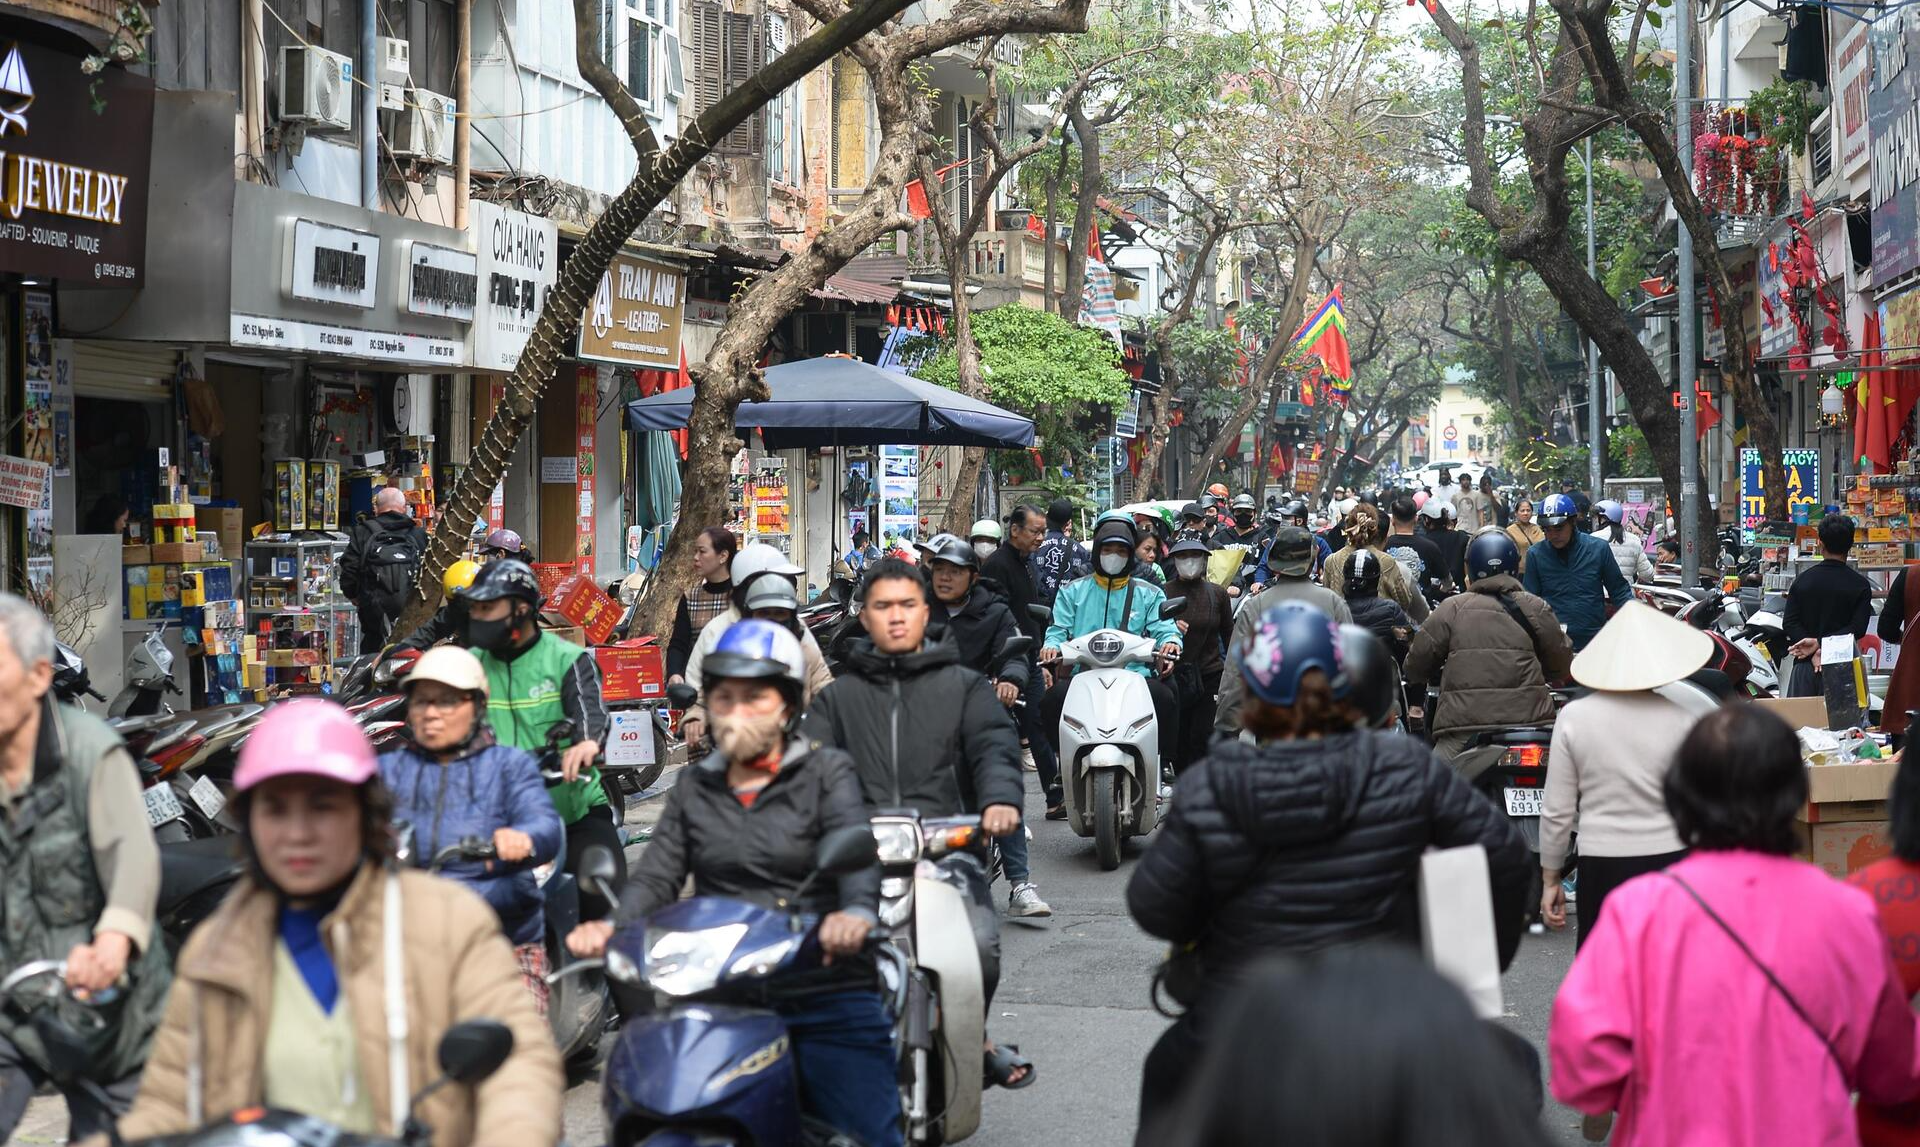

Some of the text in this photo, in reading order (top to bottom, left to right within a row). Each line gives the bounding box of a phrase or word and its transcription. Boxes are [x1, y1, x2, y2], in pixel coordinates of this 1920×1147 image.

[10, 154, 128, 224] JEWELRY
[32, 227, 68, 248] SOUVENIR
[74, 235, 100, 255] UNIQUE
[517, 215, 544, 271] HÀNG
[652, 272, 677, 308] ANH
[517, 325, 533, 335] JEWEL
[628, 310, 659, 333] LEATHER
[56, 359, 68, 385] 52
[621, 732, 638, 741] 60
